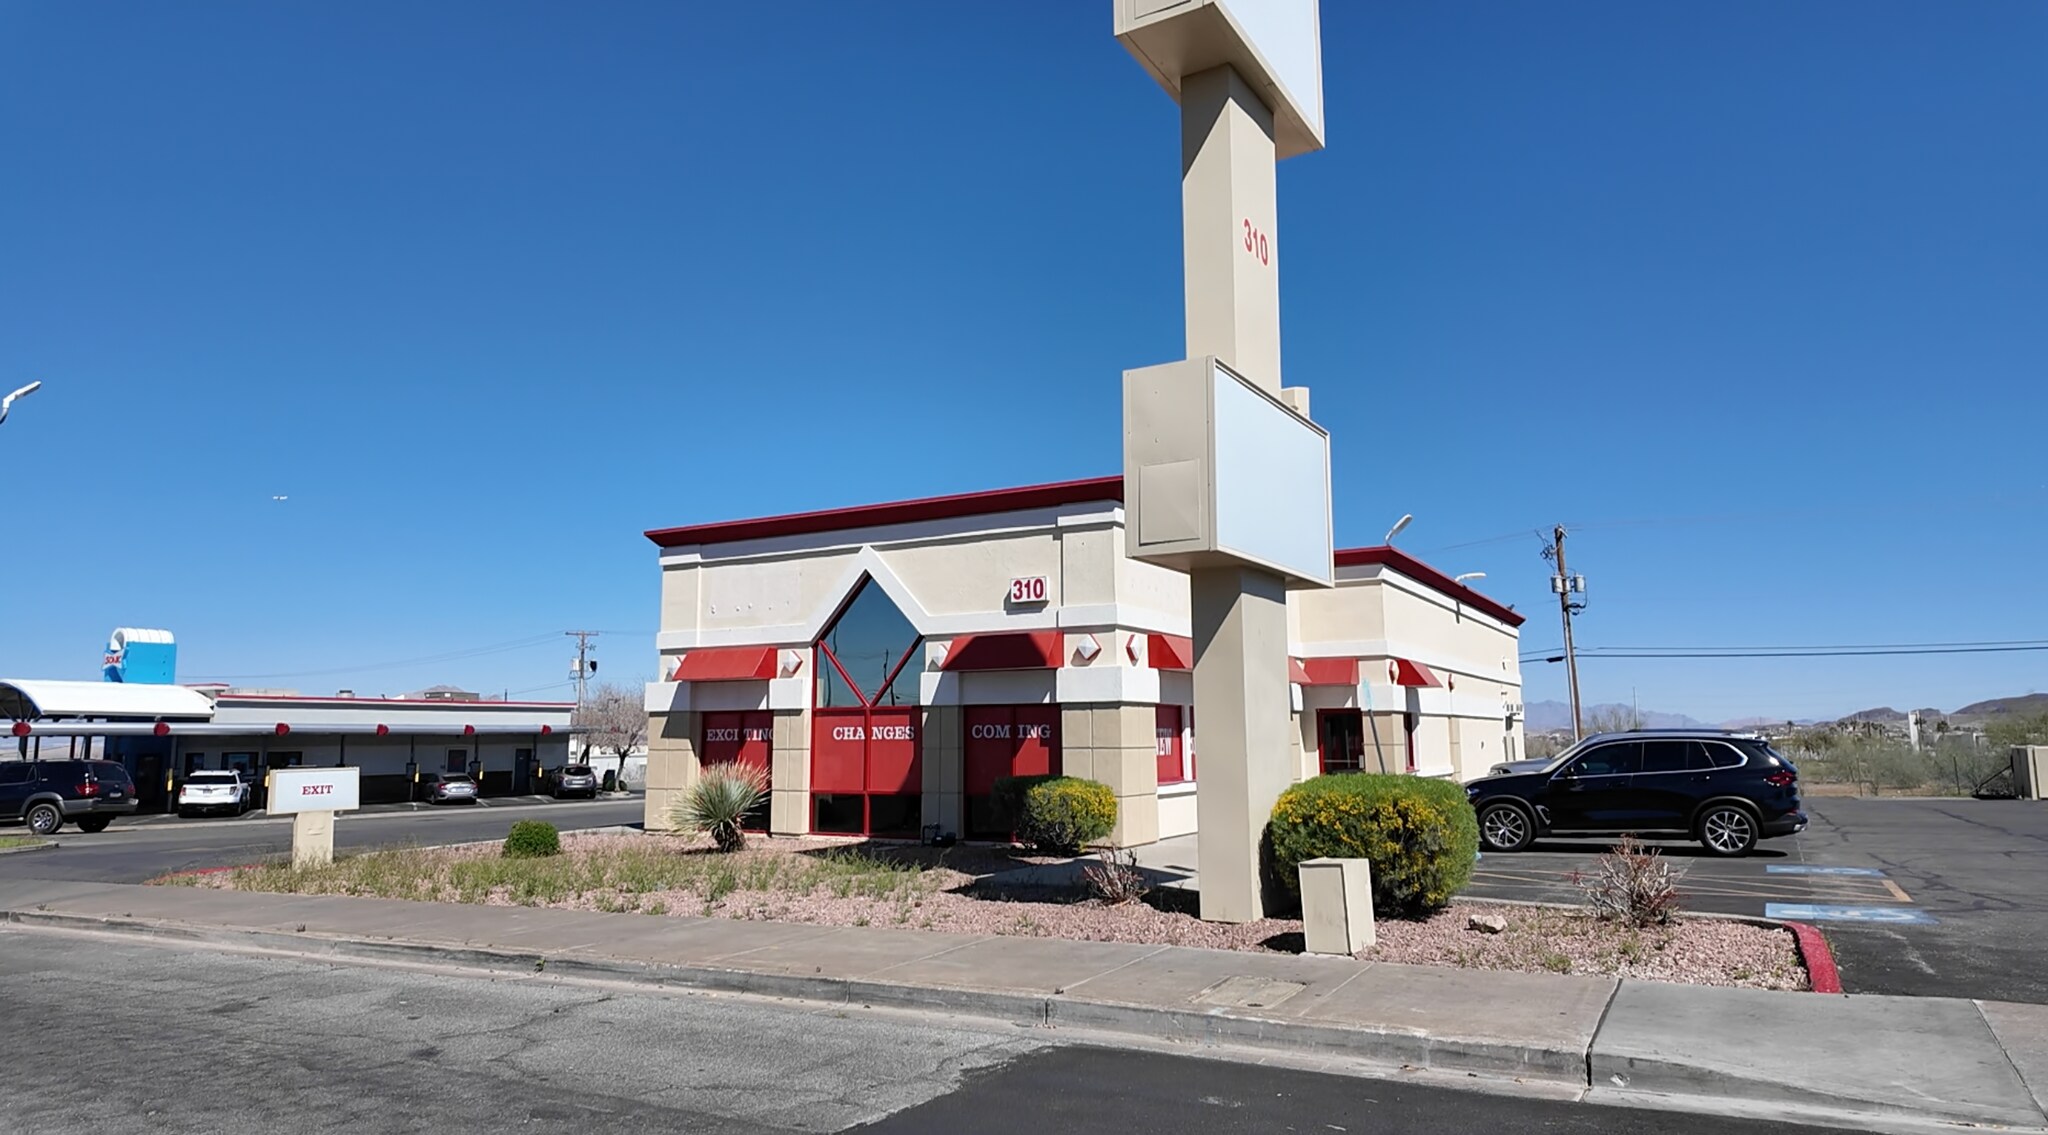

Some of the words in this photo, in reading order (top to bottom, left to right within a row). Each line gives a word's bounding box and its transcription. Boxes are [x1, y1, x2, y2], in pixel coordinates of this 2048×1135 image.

[1244, 218, 1268, 266] 310
[1013, 578, 1044, 600] 310
[302, 784, 334, 796] EXIT
